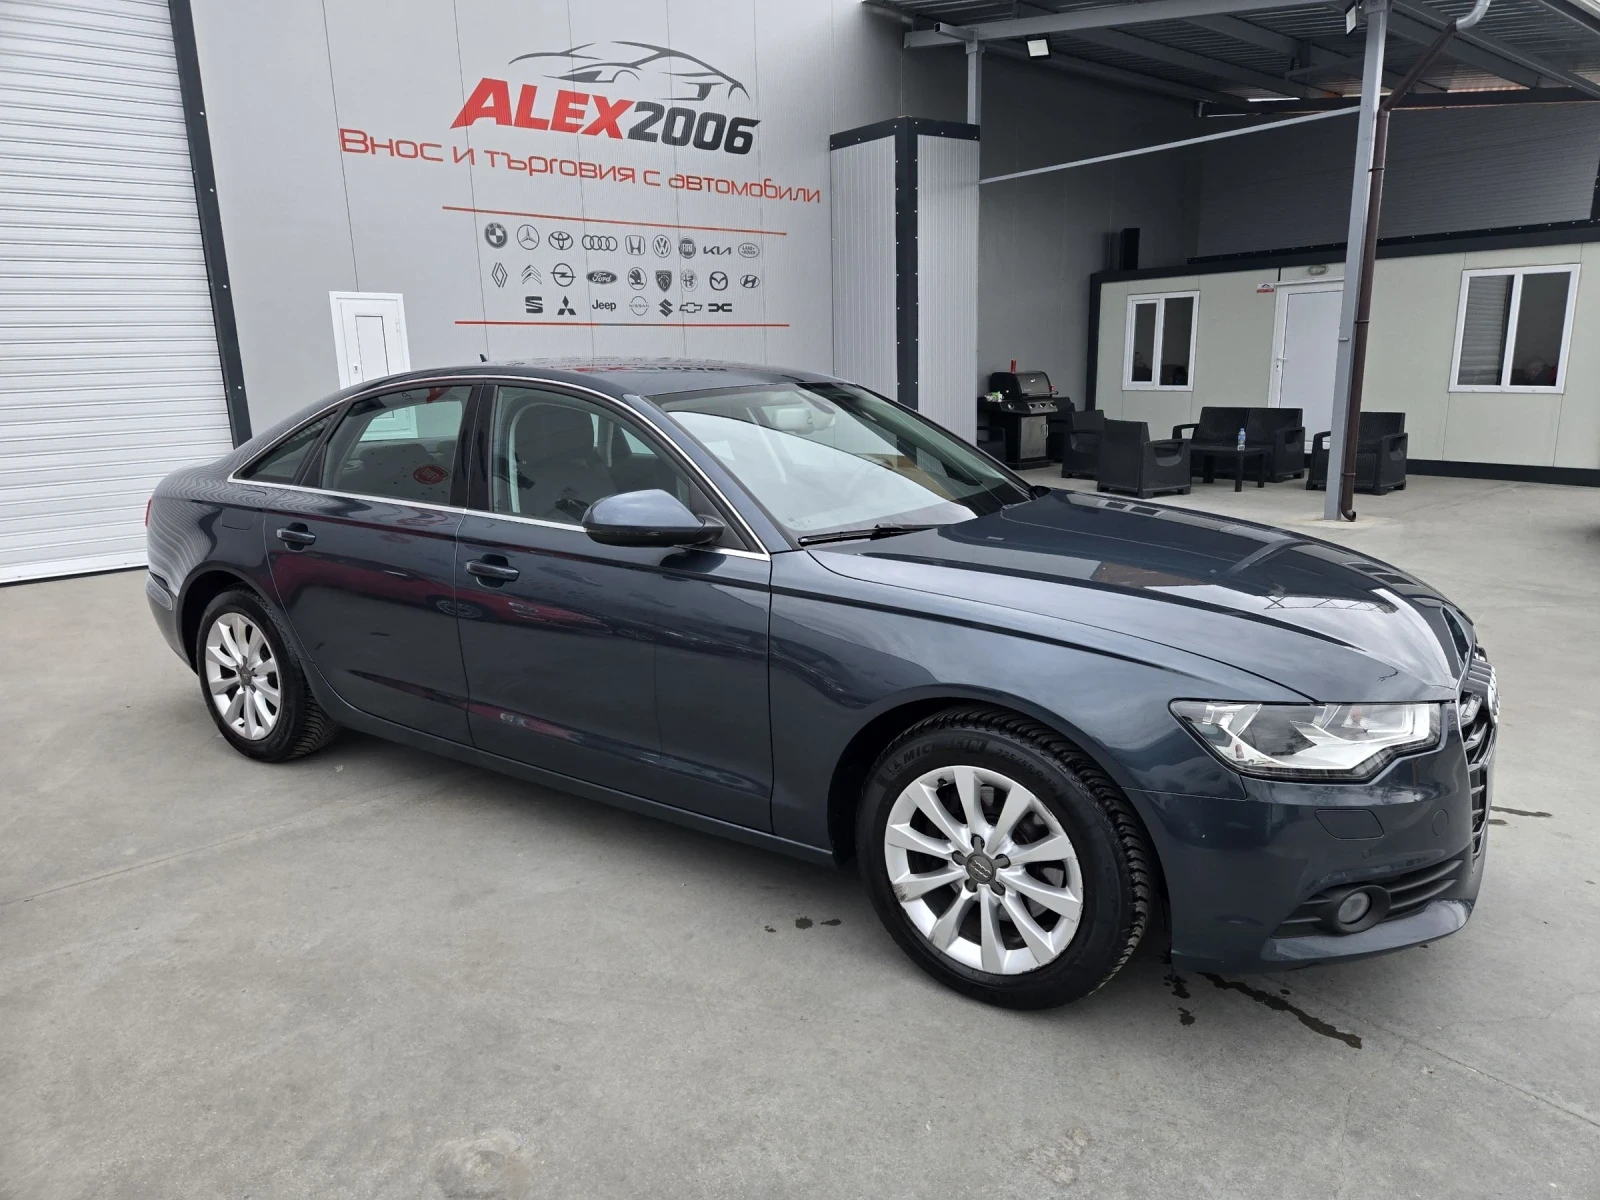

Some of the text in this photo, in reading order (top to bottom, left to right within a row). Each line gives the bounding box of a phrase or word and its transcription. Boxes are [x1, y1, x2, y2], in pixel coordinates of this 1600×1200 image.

[449, 77, 761, 155] ALEX2006
[339, 128, 820, 203] Внос и търговия с автомобили
[703, 245, 732, 255] KIA
[591, 271, 612, 283] Ford
[592, 299, 617, 312] Jeep
